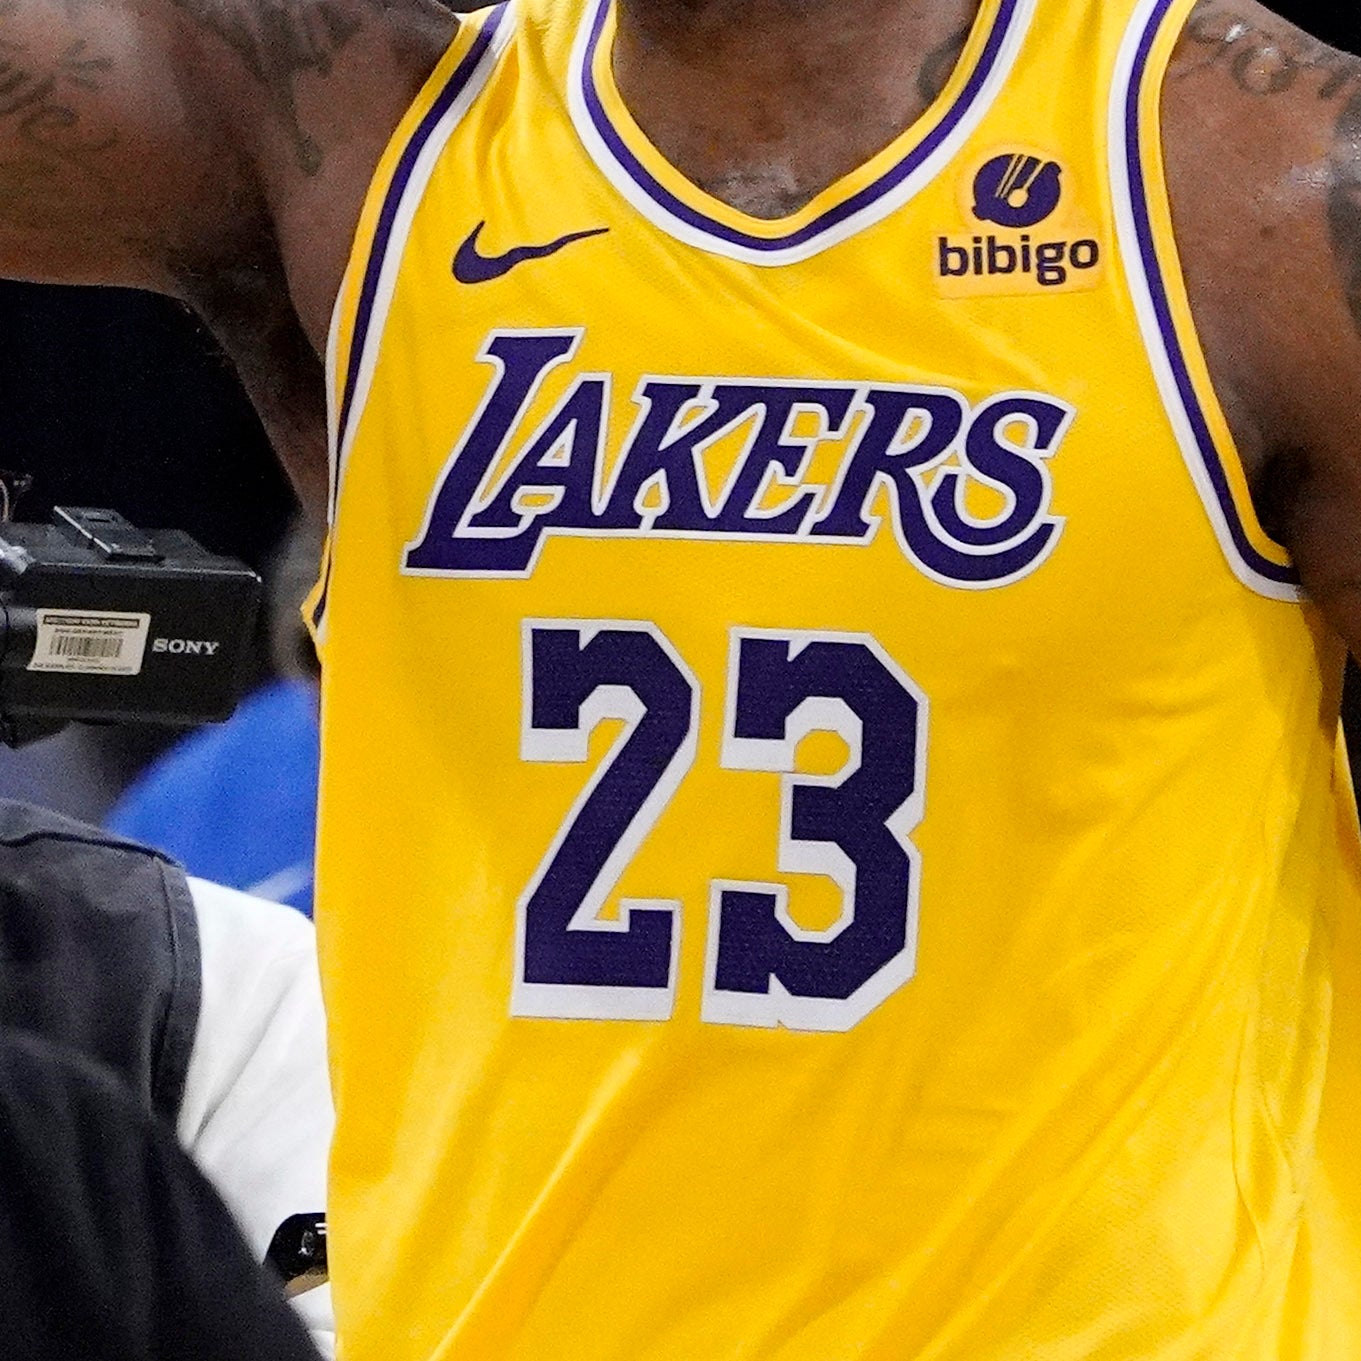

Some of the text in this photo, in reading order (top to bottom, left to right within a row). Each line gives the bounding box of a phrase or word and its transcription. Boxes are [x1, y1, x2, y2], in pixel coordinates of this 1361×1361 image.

[938, 234, 1099, 286] bibigo
[400, 327, 1077, 590] LAKERS
[152, 638, 220, 655] SONY
[510, 618, 930, 1033] 23
